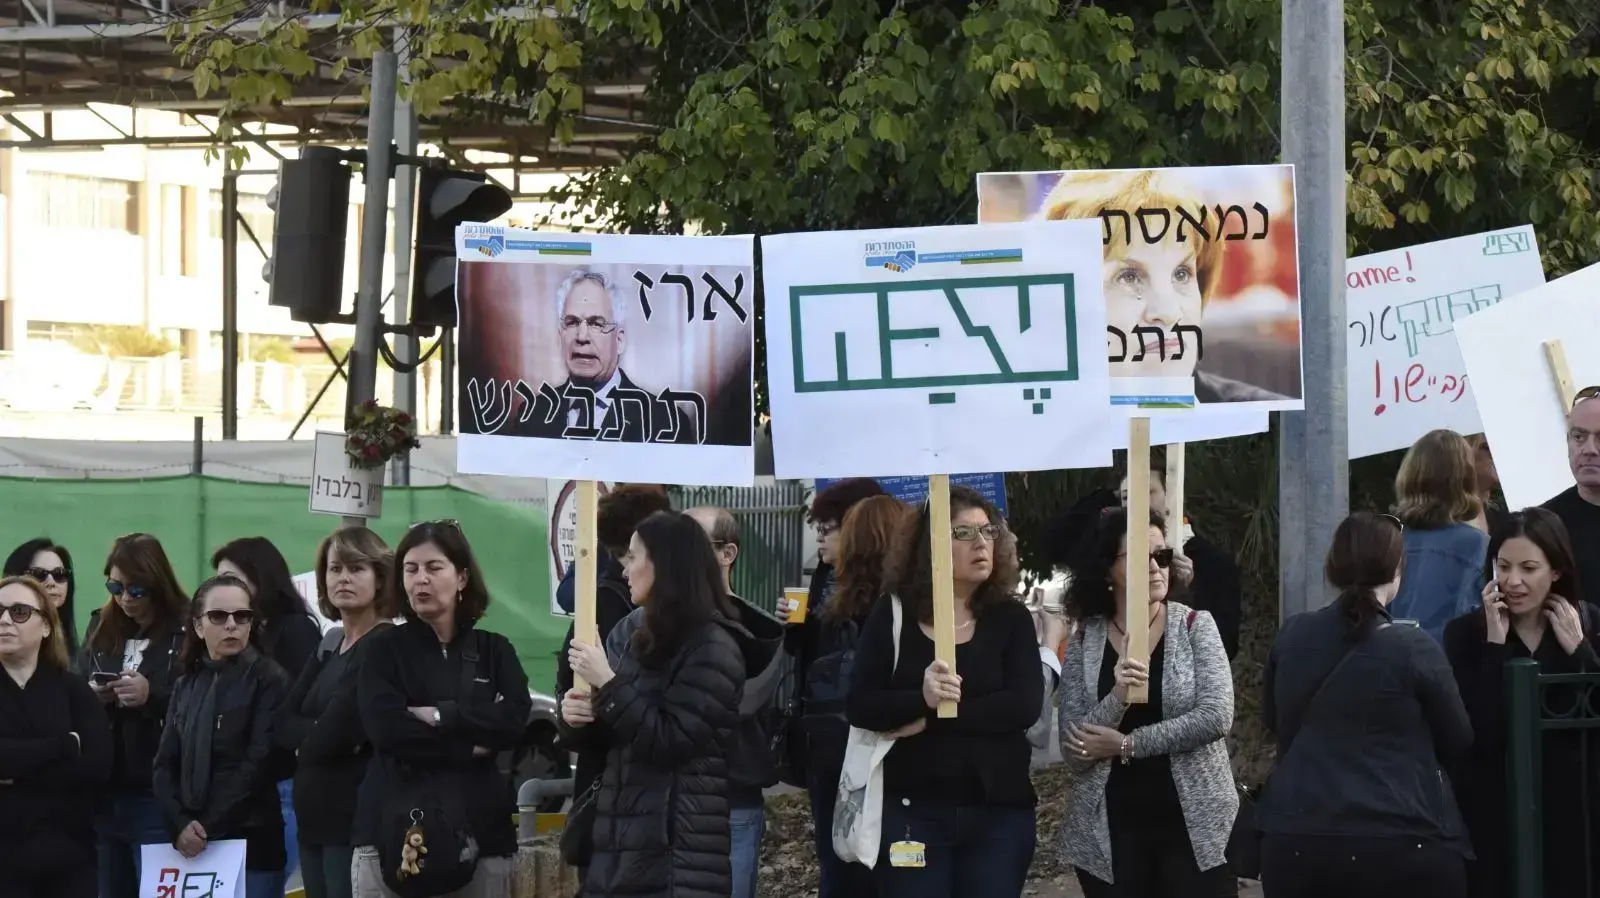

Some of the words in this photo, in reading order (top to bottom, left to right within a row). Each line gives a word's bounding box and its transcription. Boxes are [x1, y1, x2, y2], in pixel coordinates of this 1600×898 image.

[865, 240, 915, 251] ההסתדרות
[1346, 251, 1416, 288] ame!
[633, 269, 748, 324] ארז
[467, 377, 707, 445] תתבייש
[316, 475, 361, 499] בלבד!
